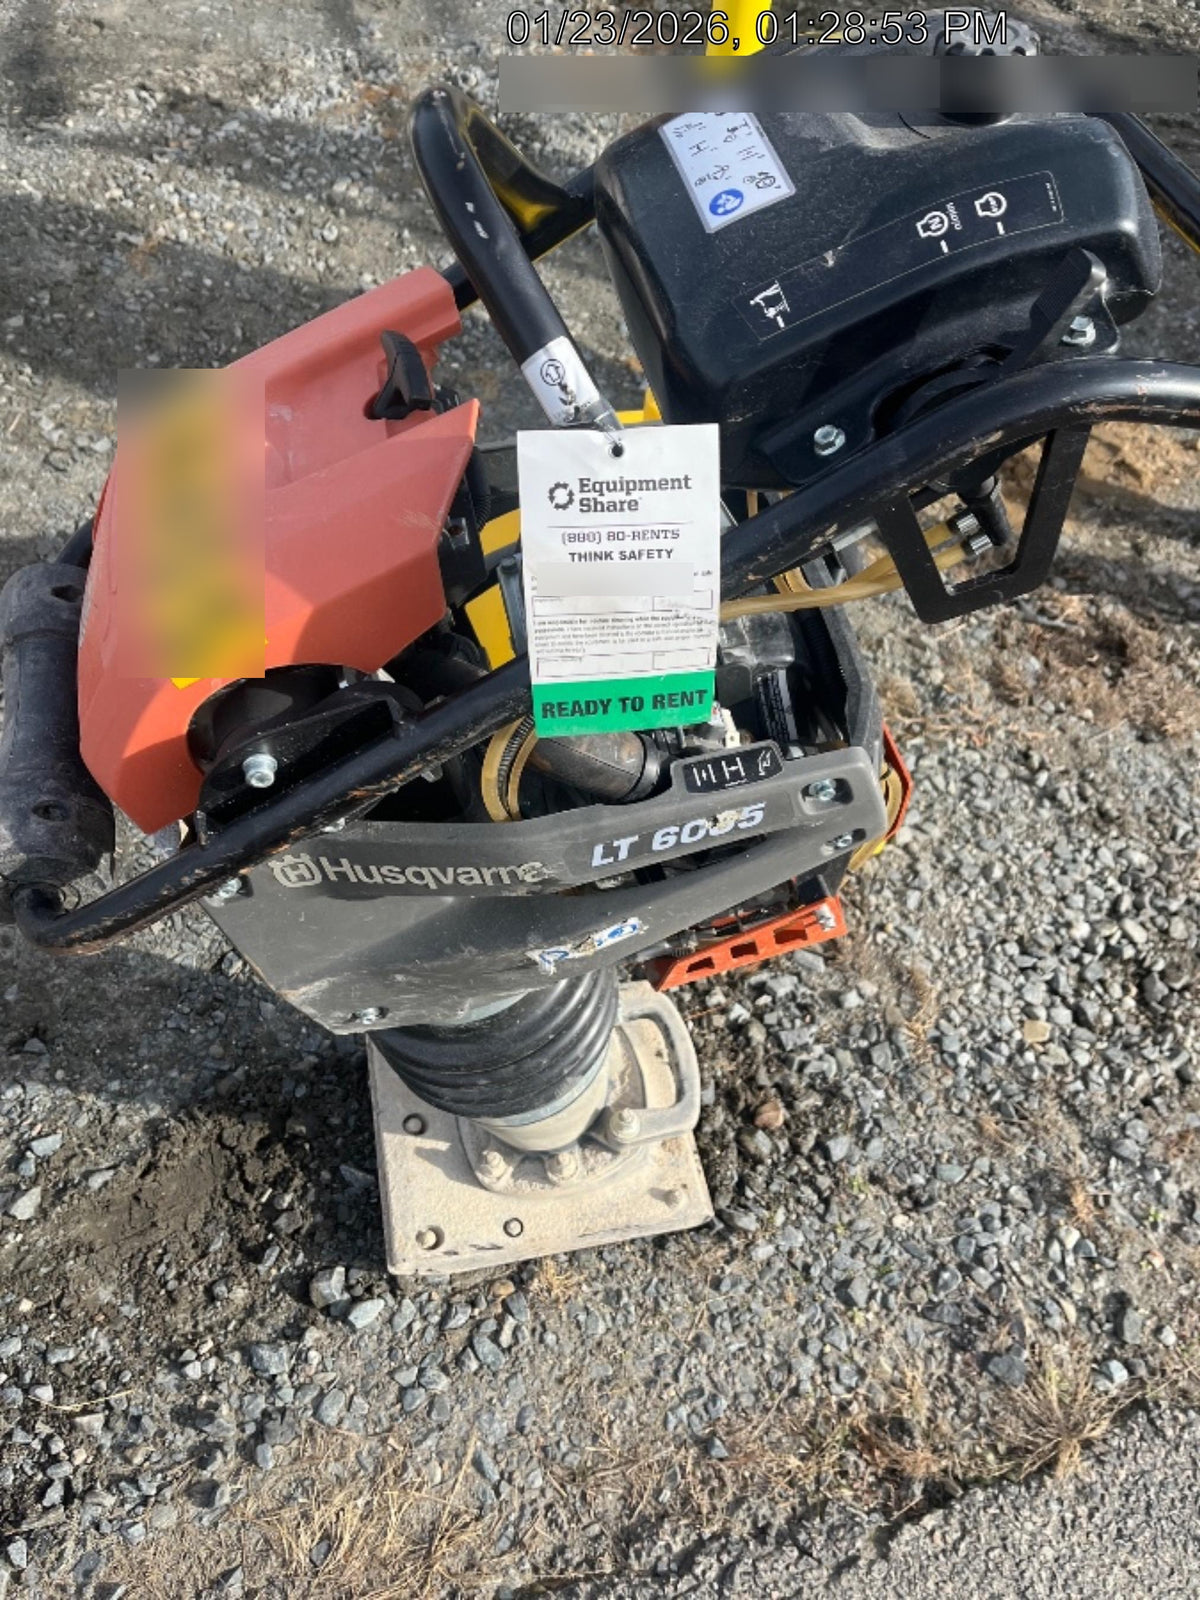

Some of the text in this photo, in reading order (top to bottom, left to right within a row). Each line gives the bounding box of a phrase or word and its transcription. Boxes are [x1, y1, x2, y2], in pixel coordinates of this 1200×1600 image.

[578, 474, 692, 496] Equipment
[579, 497, 639, 513] Share
[607, 528, 680, 542] 80-RENTS
[569, 549, 674, 563] THINK SAFETY
[541, 689, 708, 719] READY TO RENT
[591, 834, 640, 868] LT
[317, 855, 551, 890] Husqvarna
